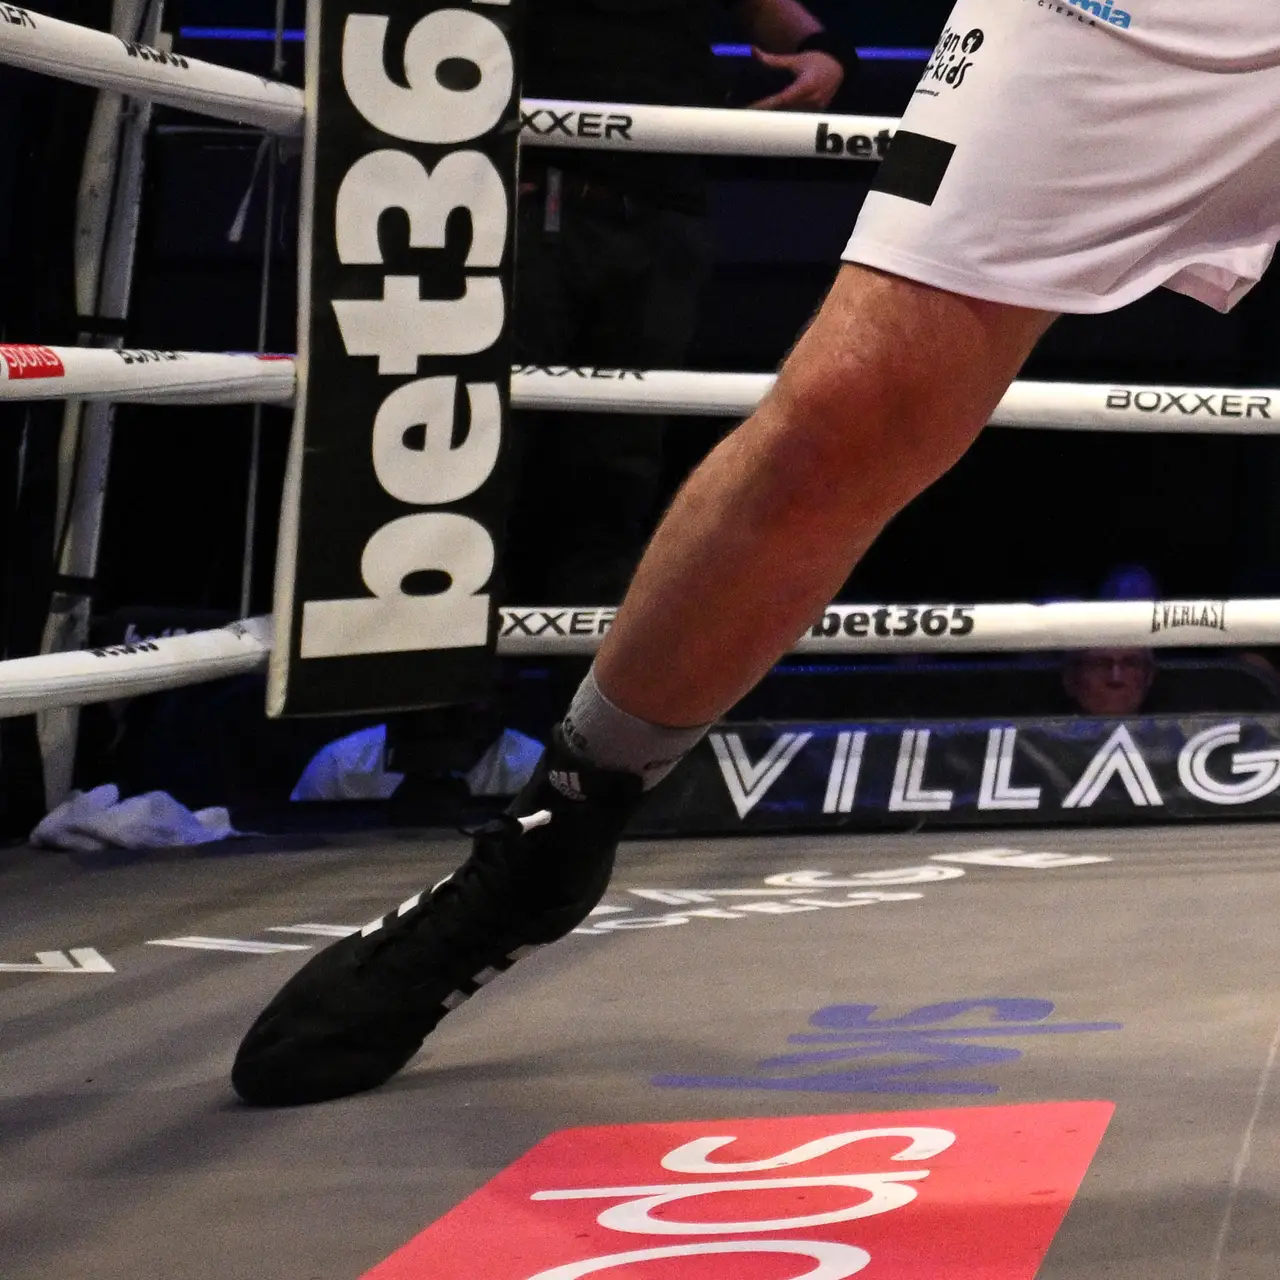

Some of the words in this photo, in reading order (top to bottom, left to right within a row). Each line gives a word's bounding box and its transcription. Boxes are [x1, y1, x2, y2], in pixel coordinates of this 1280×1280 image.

[0, 346, 60, 376] sports
[1105, 388, 1273, 419] BOXXER
[811, 604, 975, 638] bet365
[1151, 601, 1229, 634] EVERLAST
